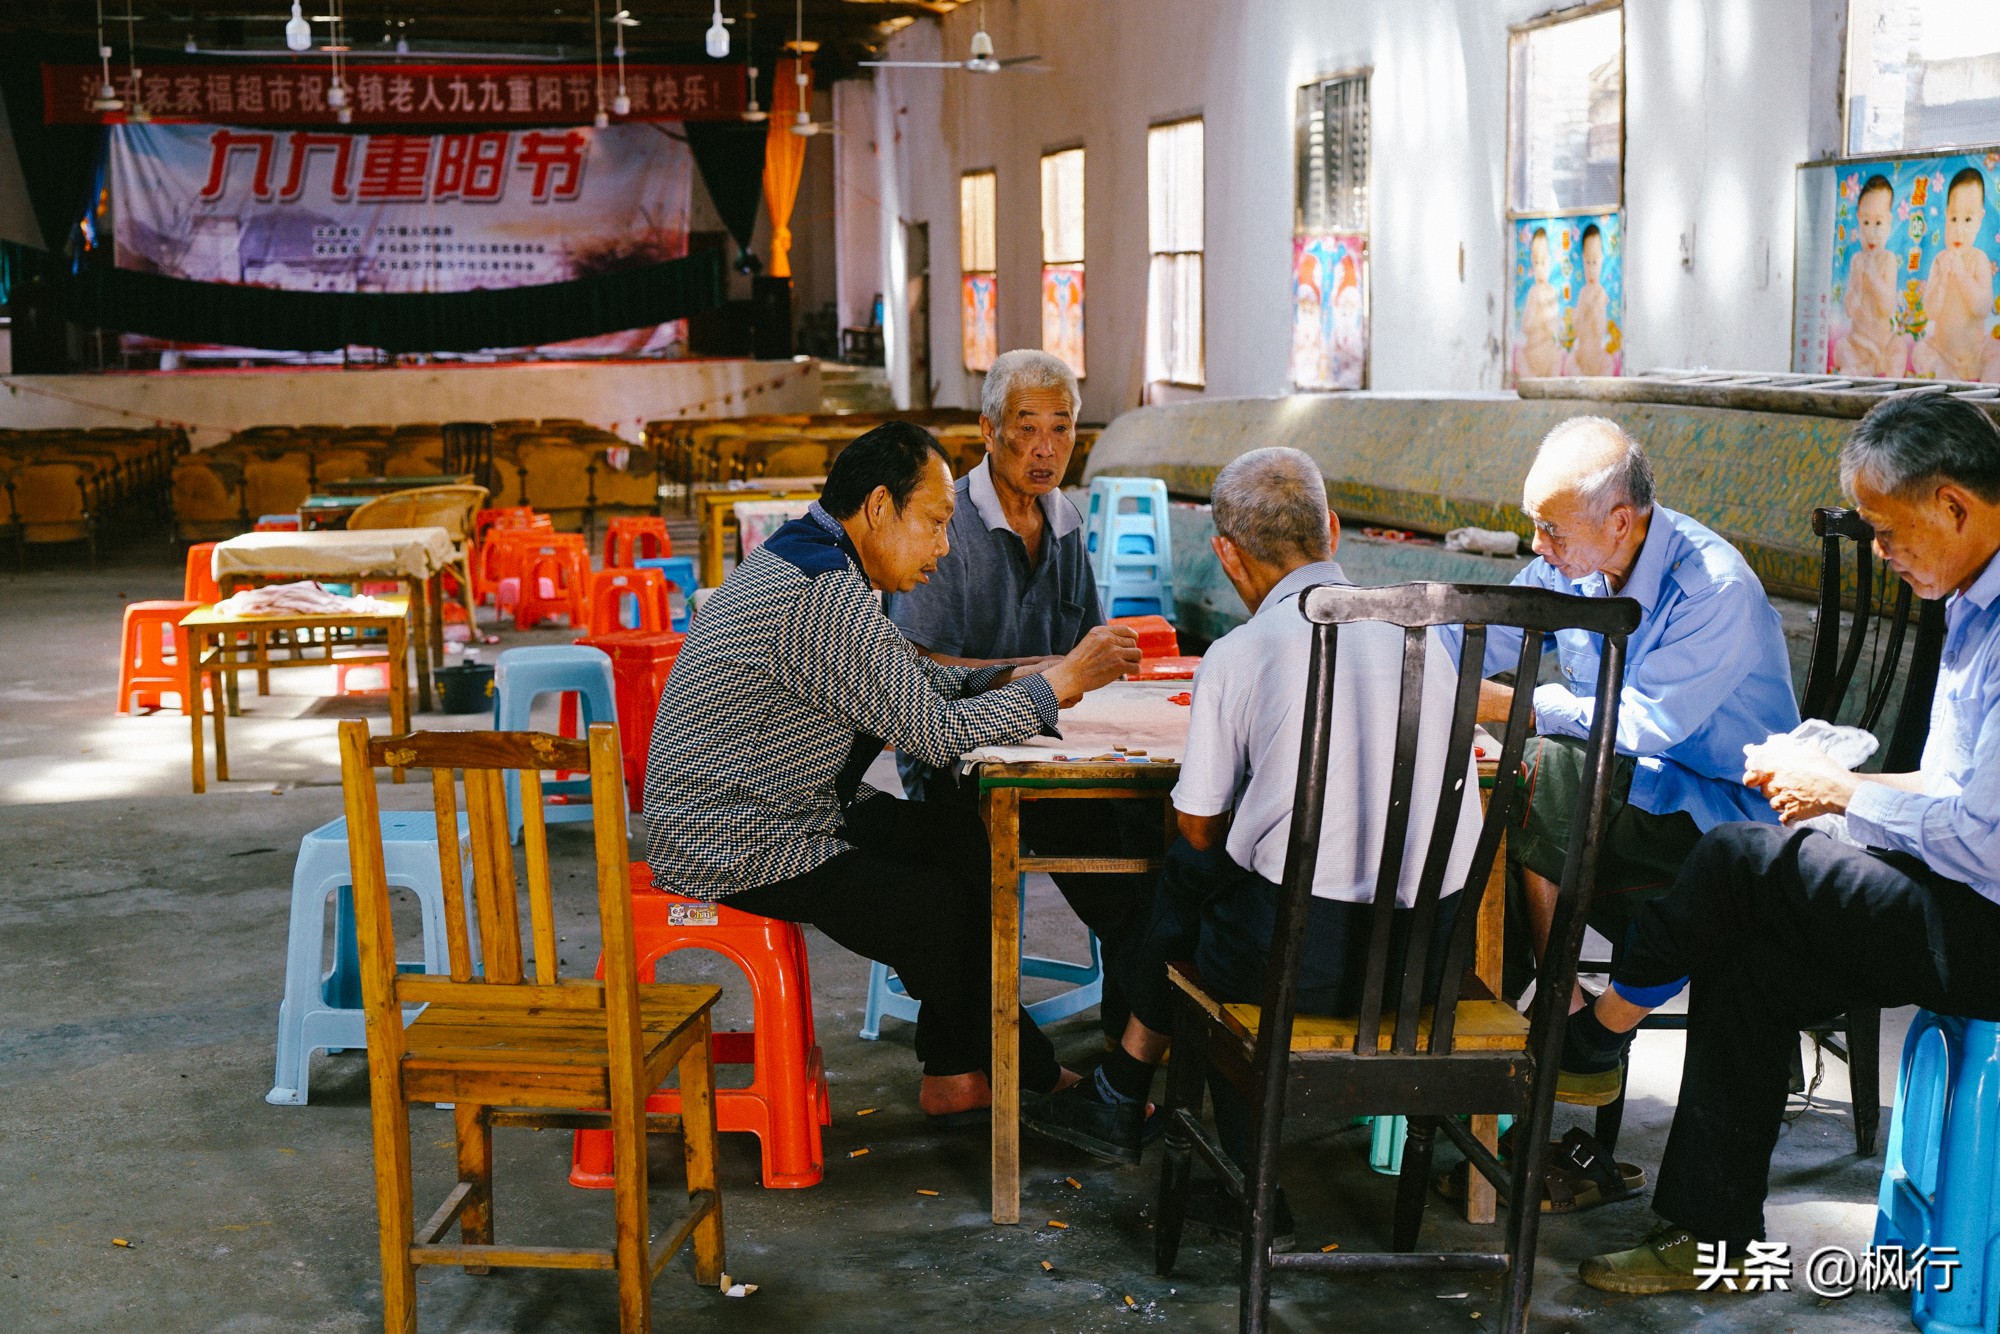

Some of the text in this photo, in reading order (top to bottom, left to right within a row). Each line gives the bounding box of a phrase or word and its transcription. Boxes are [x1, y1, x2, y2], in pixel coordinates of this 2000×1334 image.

[201, 129, 588, 202] 九九重阳节
[687, 908, 715, 920] Chair
